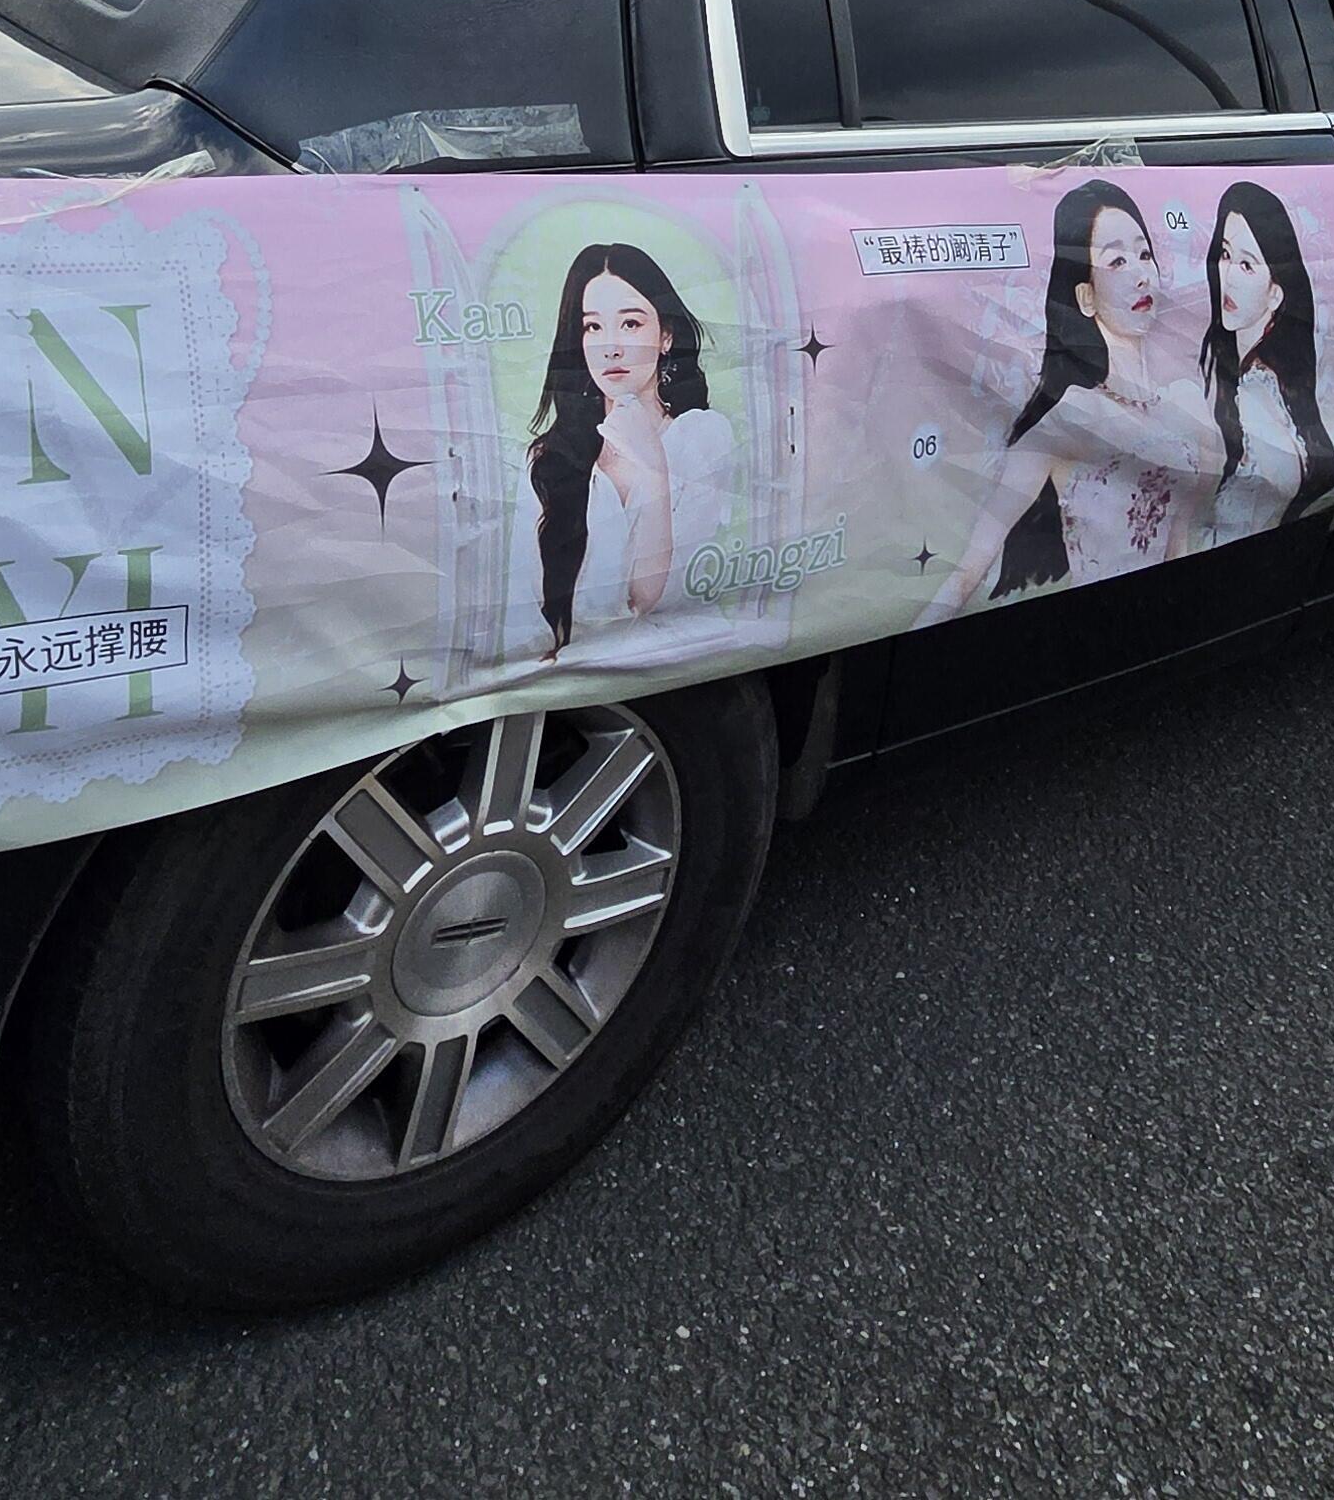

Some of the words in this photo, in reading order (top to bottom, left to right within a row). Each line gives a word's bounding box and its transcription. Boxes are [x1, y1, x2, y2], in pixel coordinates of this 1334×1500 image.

[1165, 210, 1189, 232] 04
[862, 231, 1018, 266] “最棒的阚清子”
[408, 289, 533, 344] Kan
[912, 434, 937, 460] 06
[684, 513, 847, 602] Qingzi
